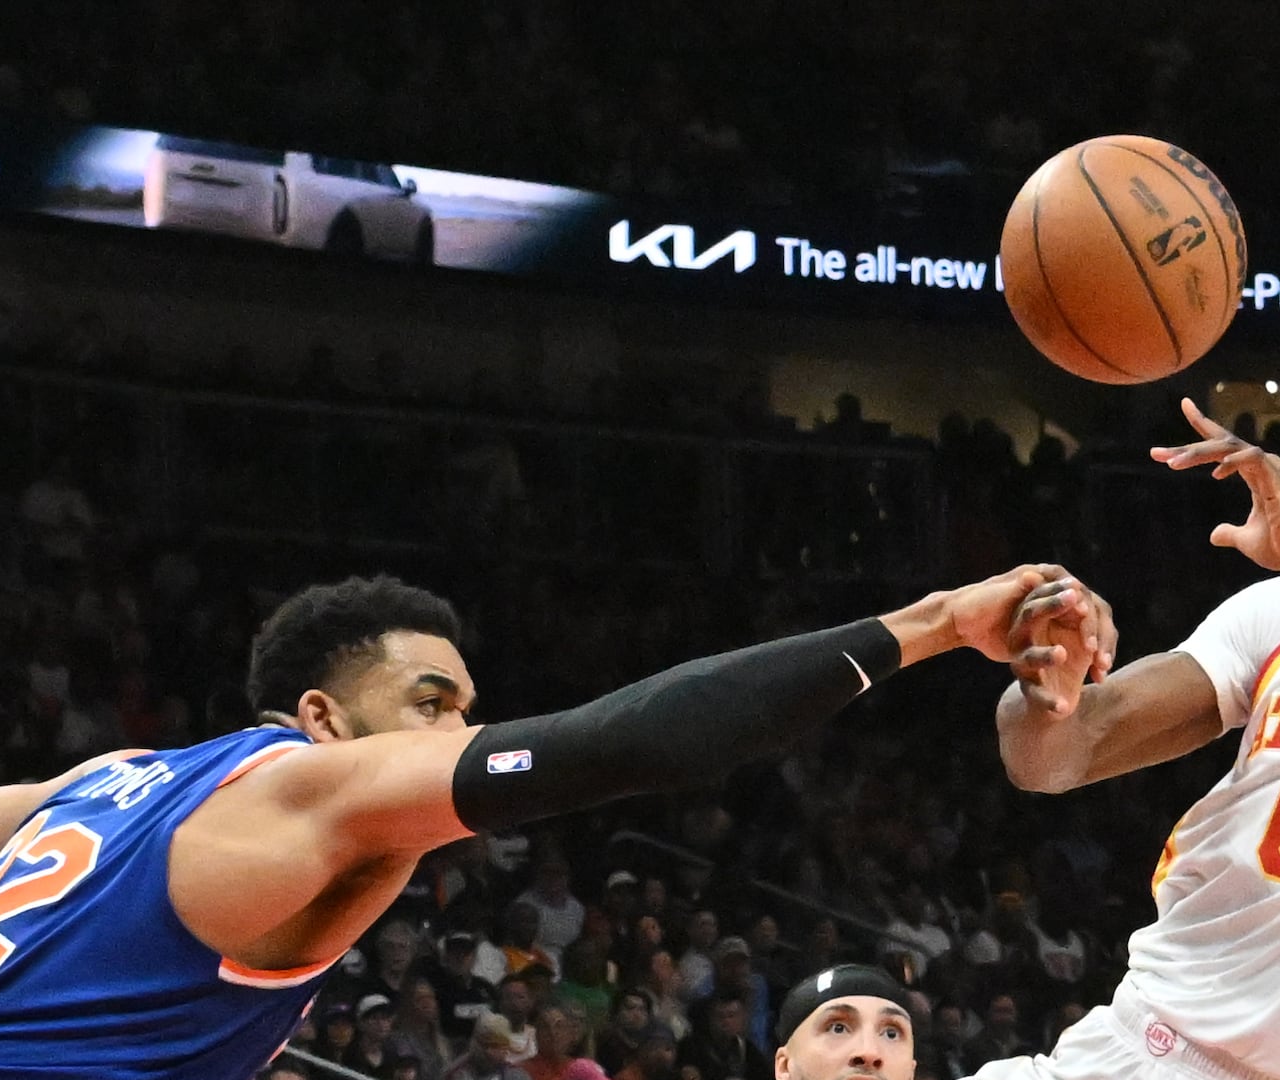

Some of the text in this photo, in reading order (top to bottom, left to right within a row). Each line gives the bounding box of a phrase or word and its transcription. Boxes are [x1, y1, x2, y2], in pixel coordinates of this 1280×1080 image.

[609, 219, 756, 273] KIA
[775, 236, 846, 281] The
[854, 245, 988, 291] all-new
